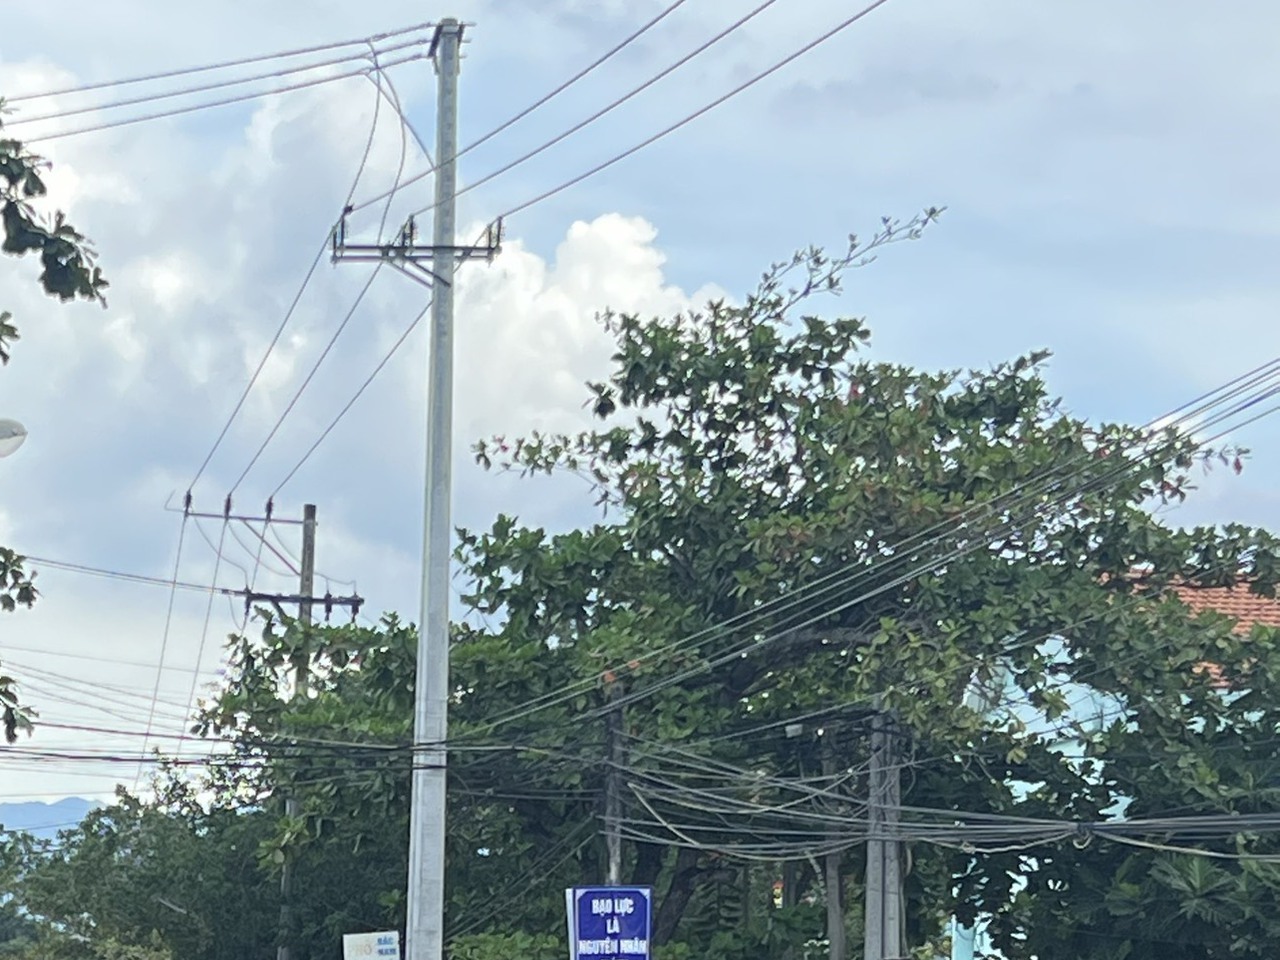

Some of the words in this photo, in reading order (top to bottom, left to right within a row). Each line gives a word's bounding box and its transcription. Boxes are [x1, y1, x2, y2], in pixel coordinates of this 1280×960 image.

[592, 899, 611, 917] BẠO
[614, 898, 634, 917] LỰC
[606, 918, 620, 934] LÀ
[579, 939, 618, 955] NGUYÊN
[620, 939, 647, 955] NHÂN
